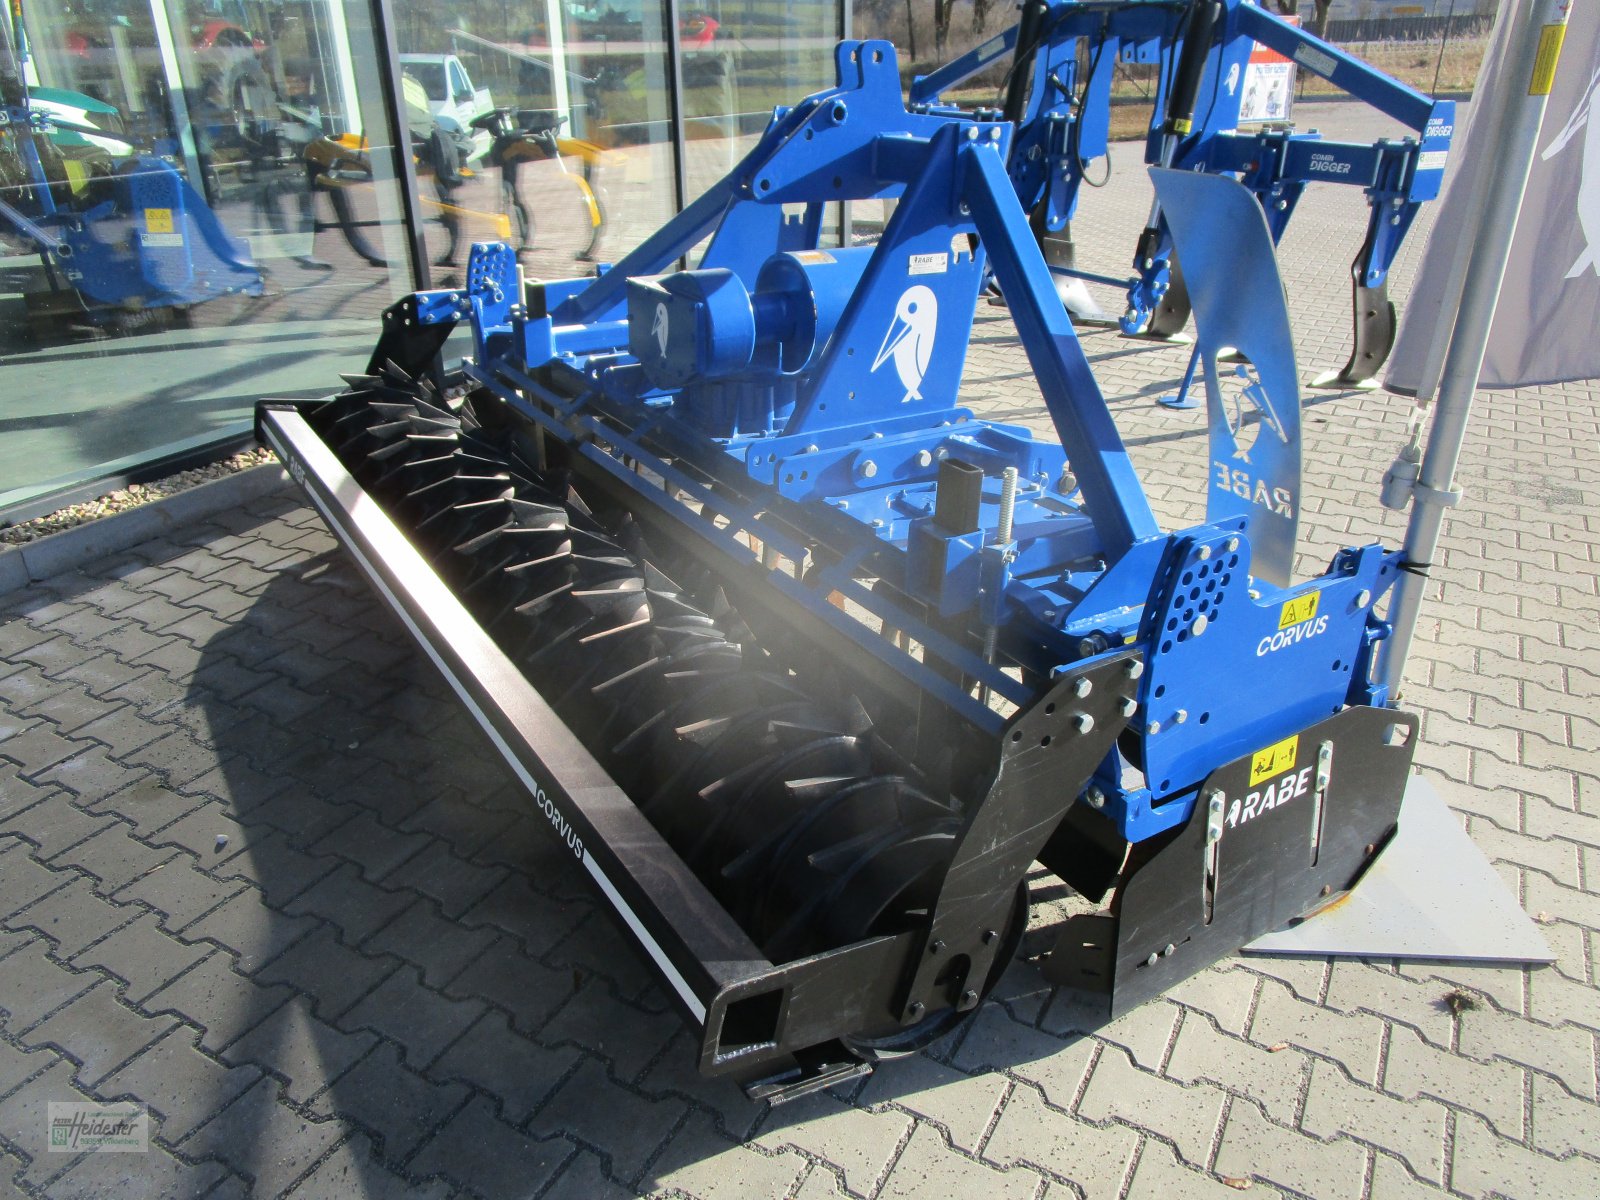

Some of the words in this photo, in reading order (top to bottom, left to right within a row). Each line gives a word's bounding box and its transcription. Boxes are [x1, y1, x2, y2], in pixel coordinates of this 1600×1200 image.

[1426, 126, 1452, 136] DIGGER
[1309, 161, 1351, 174] DIGGER
[1311, 153, 1334, 162] COMBI
[1255, 615, 1329, 657] CORVUS
[1241, 766, 1313, 824] RABE
[537, 789, 583, 859] CORVUS
